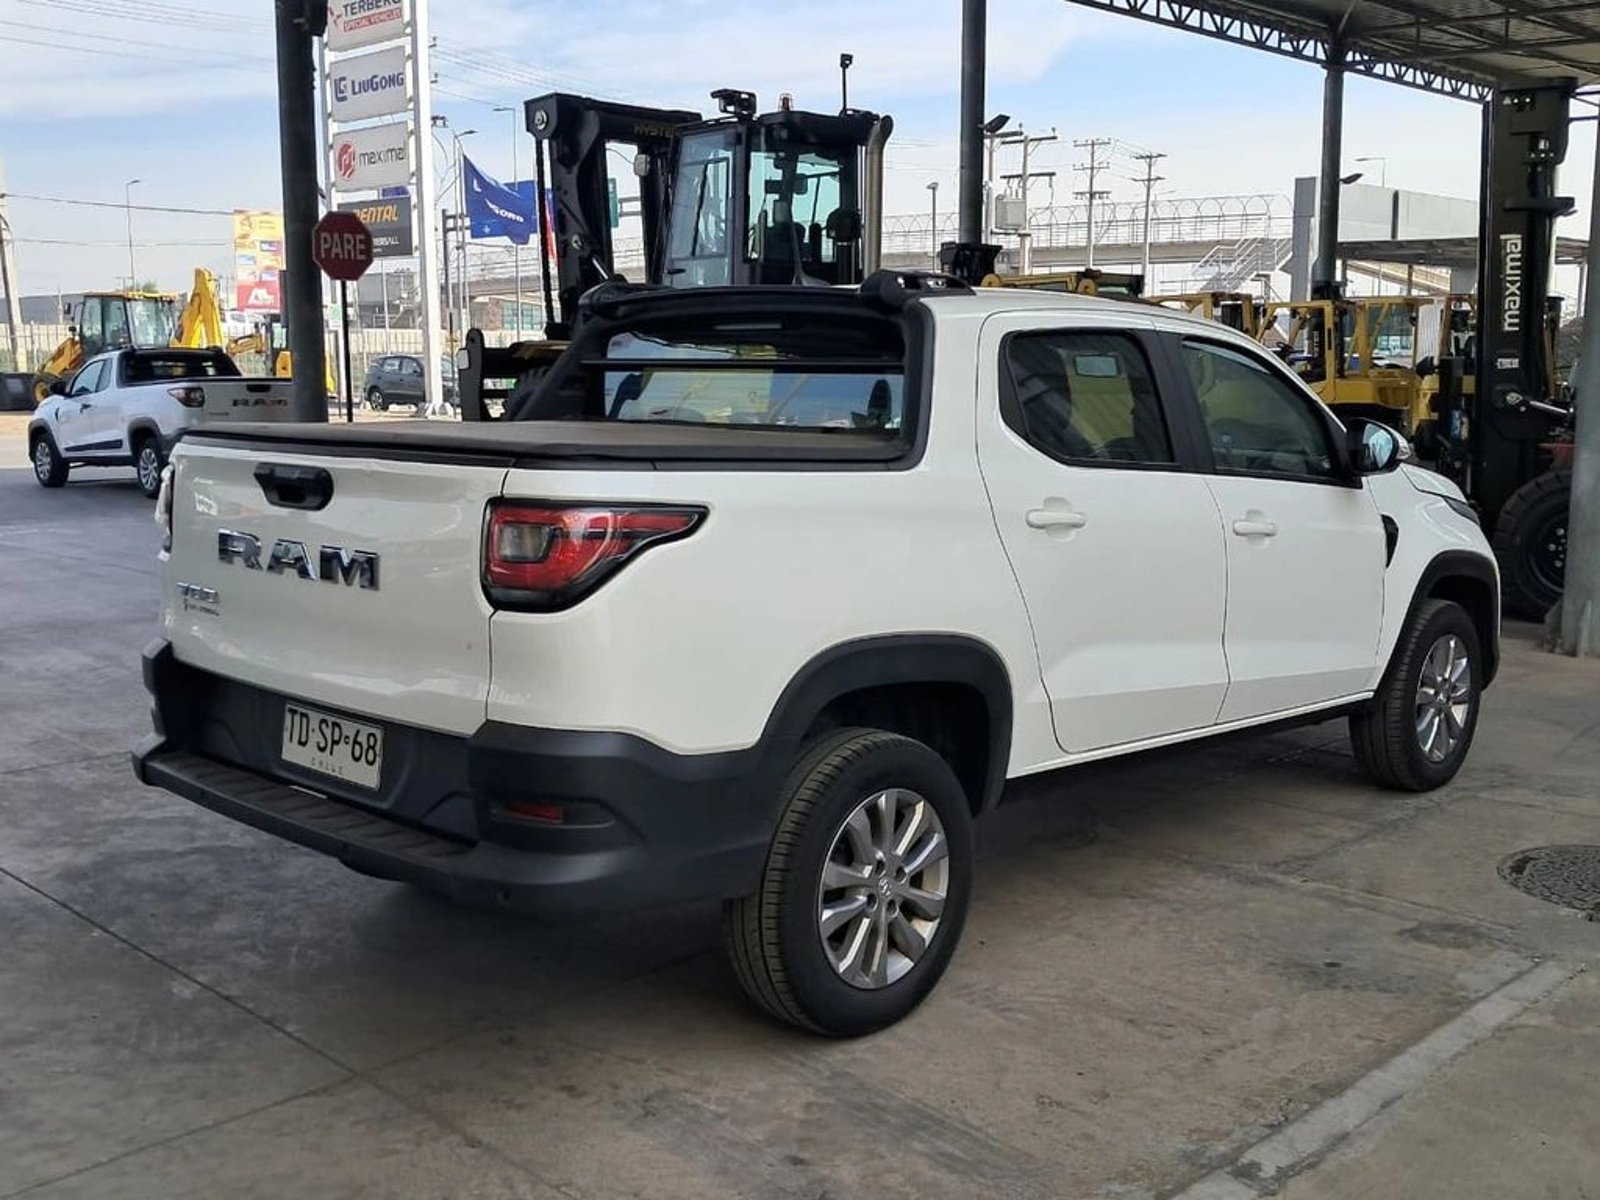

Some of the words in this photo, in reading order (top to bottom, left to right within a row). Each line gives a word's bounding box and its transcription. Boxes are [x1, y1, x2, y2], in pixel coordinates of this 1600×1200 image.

[342, 0, 401, 17] TERBE
[351, 72, 405, 96] LIUGONG
[320, 232, 367, 260] PARE
[1500, 233, 1523, 332] maximal
[217, 526, 381, 592] RAM
